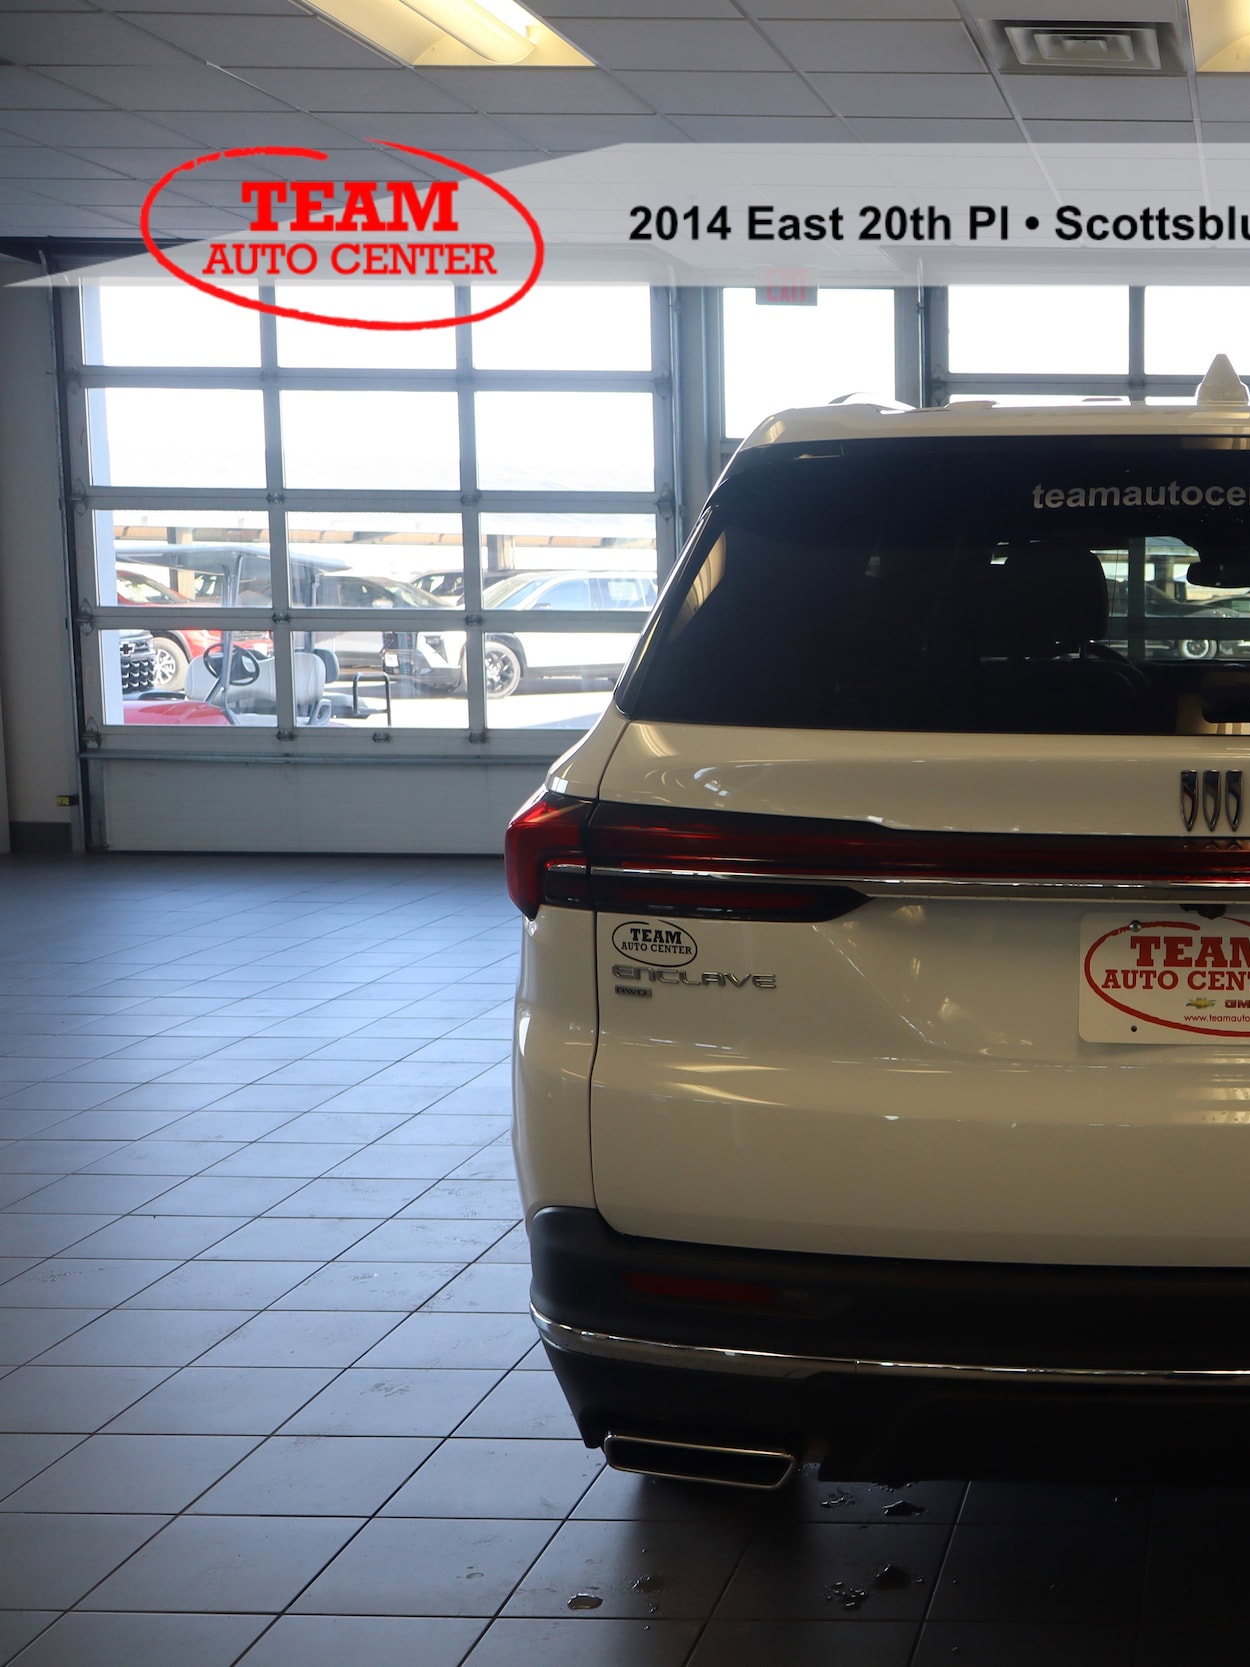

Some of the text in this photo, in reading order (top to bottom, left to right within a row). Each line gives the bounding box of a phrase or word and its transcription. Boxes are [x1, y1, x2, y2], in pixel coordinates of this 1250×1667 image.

[766, 267, 808, 303] EXIT
[630, 928, 682, 945] TEAM
[621, 941, 692, 955] AUTO CENTER
[612, 964, 777, 989] ENCLAVE
[1101, 969, 1178, 990] AUTO
